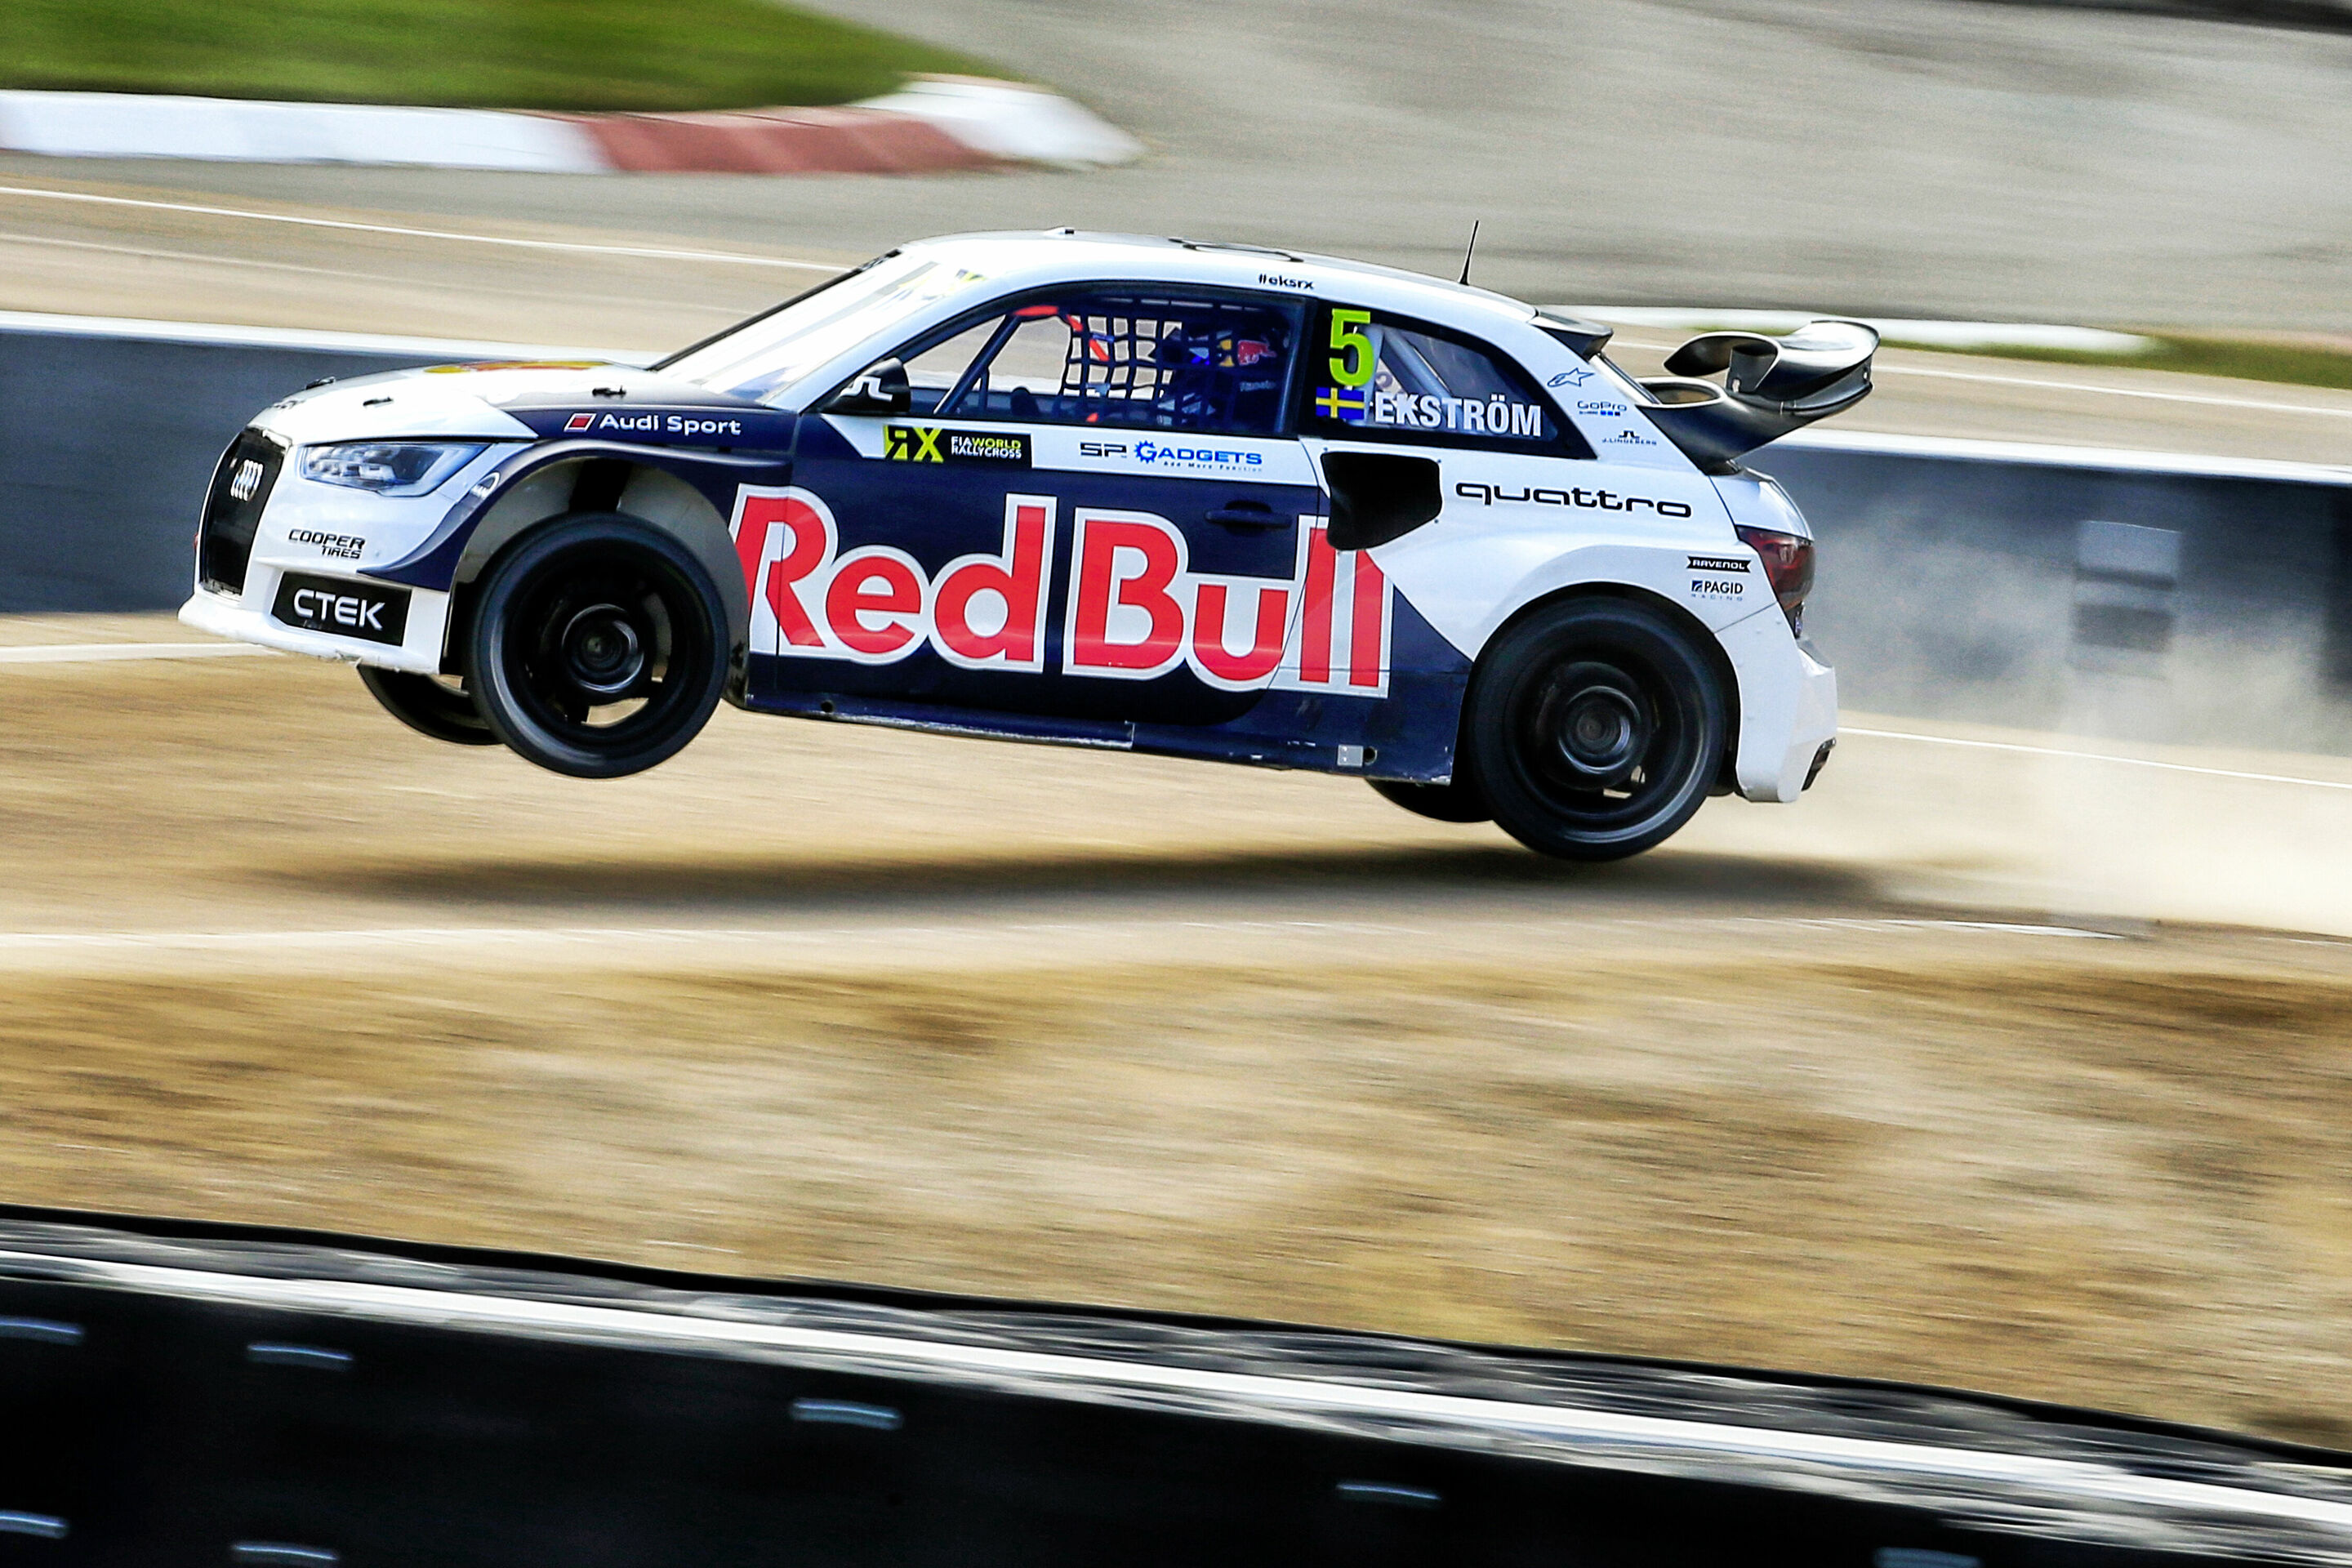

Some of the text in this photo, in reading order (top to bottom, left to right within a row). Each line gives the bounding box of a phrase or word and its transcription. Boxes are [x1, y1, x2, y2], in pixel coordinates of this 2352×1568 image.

[1330, 308, 1374, 387] 5
[1374, 391, 1541, 437] EKSTRÖM
[1577, 400, 1628, 412] GoPro
[599, 414, 742, 435] Audi Sport
[951, 445, 1022, 459] RALLYCROSS
[1134, 440, 1263, 465] GADGETS
[1455, 482, 1692, 518] quattro
[288, 528, 366, 550] COOPER
[322, 546, 362, 559] TIRES
[1692, 559, 1745, 570] RAVENOL
[731, 488, 1387, 693] Red Bull
[1704, 581, 1744, 594] PAGID
[293, 588, 386, 630] CTEK
